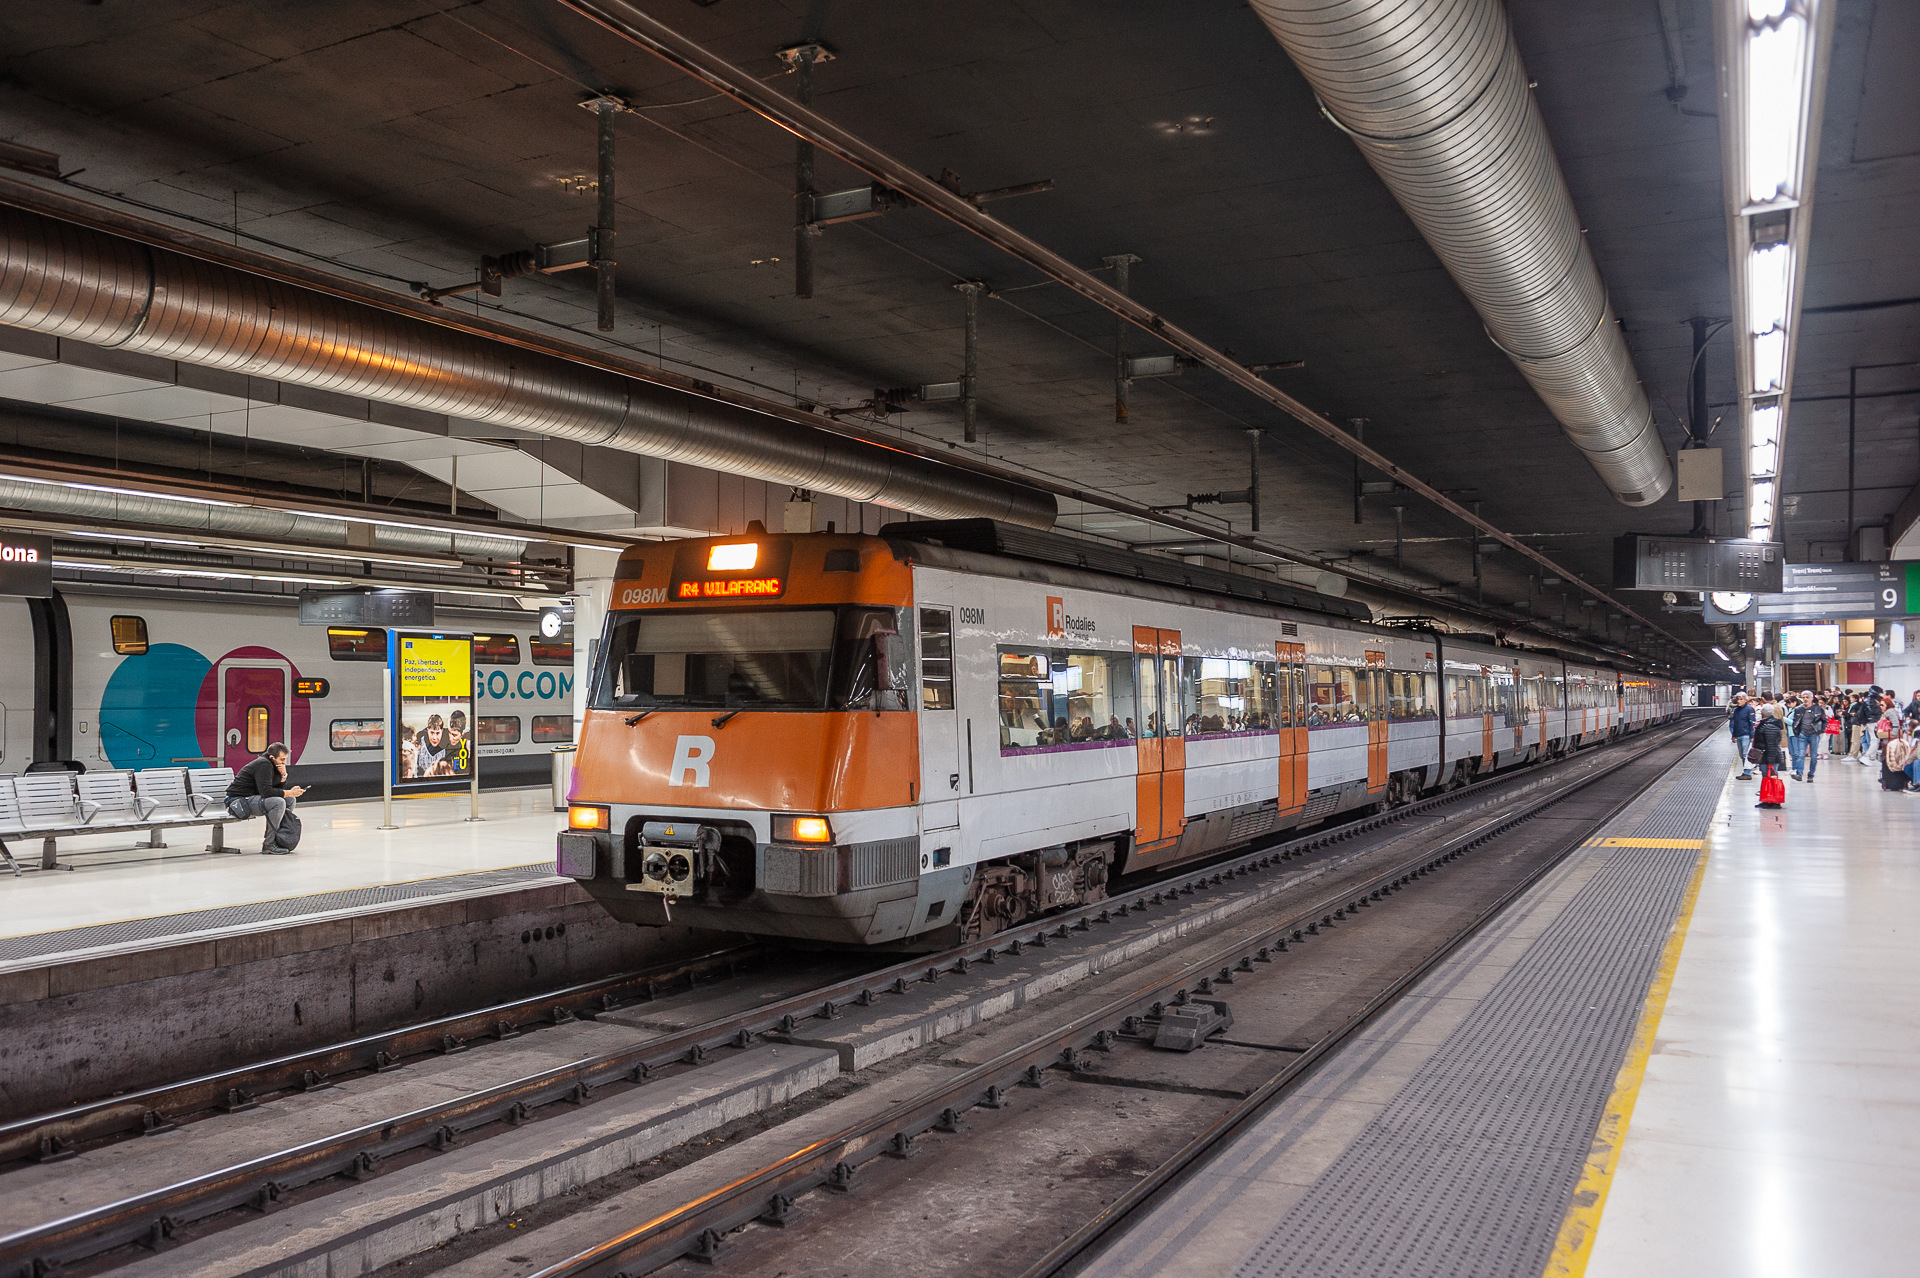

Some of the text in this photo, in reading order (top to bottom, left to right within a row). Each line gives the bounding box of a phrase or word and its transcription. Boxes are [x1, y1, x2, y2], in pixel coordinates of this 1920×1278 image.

[622, 587, 667, 604] 098M
[680, 578, 780, 597] R4 VILAFRANC
[1882, 588, 1898, 609] 9
[960, 606, 985, 625] 098M
[1053, 603, 1064, 629] R
[1065, 615, 1096, 632] Rodalies
[404, 658, 417, 666] Paz,
[404, 666, 446, 674] independencia
[668, 734, 716, 788] R
